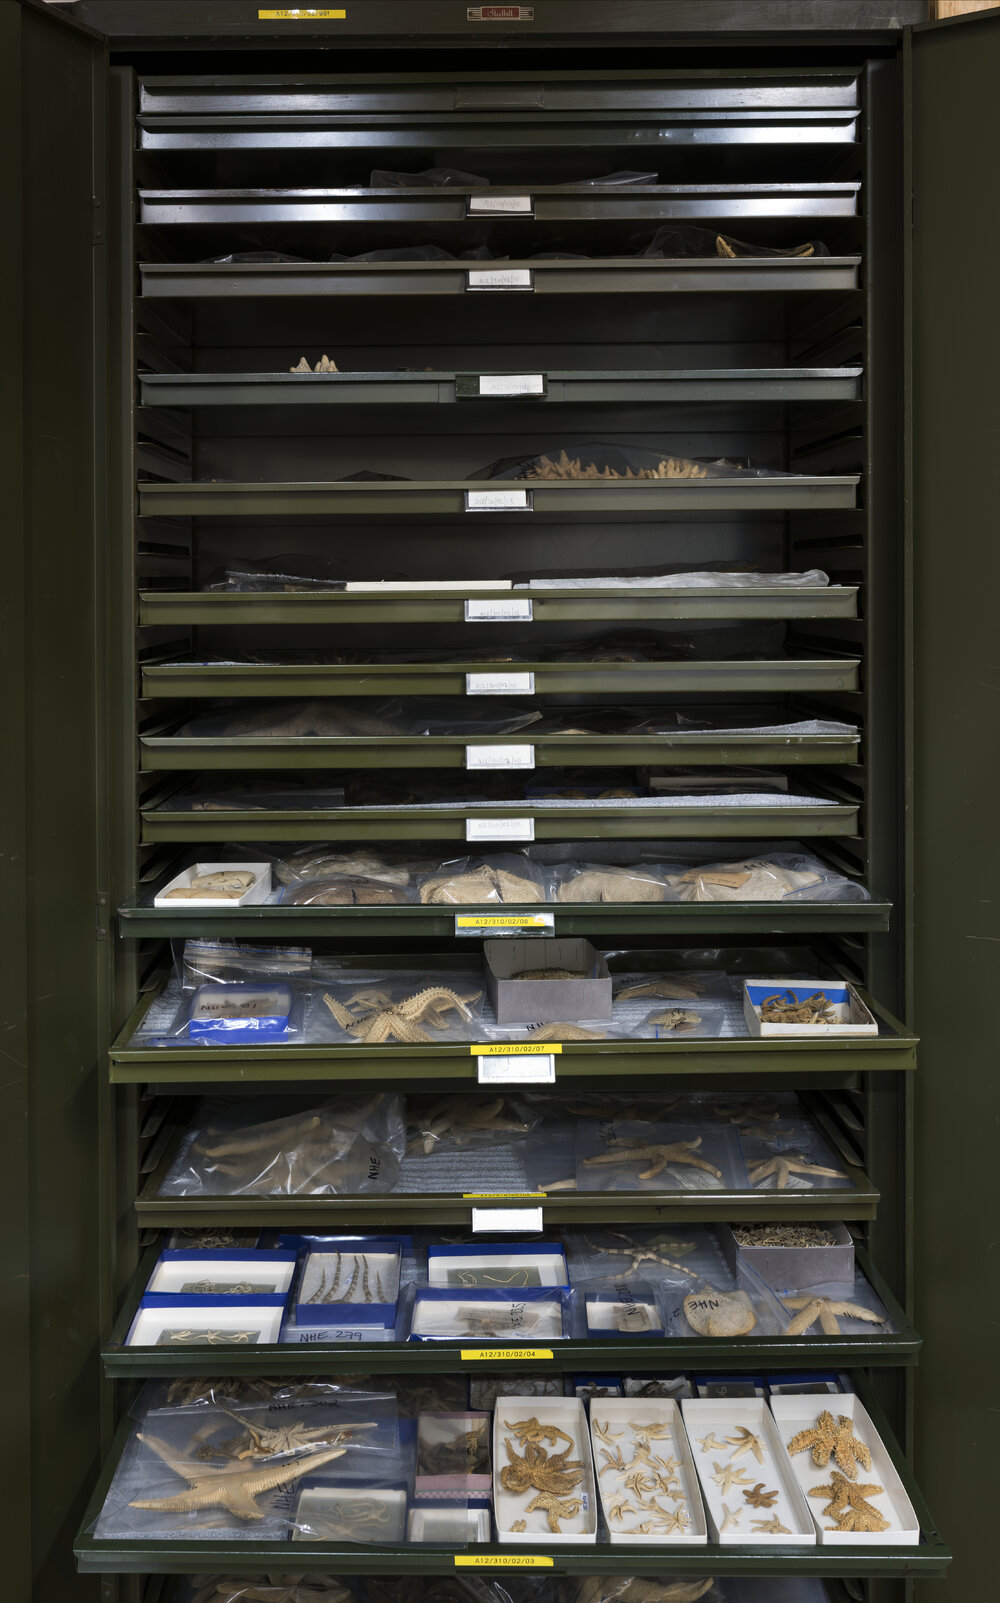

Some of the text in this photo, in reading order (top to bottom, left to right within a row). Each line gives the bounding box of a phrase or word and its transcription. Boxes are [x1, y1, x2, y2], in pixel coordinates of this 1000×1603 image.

[489, 1045, 545, 1053] A12/310/02/07
[368, 1156, 381, 1180] NHE
[688, 1299, 719, 1311] NHE
